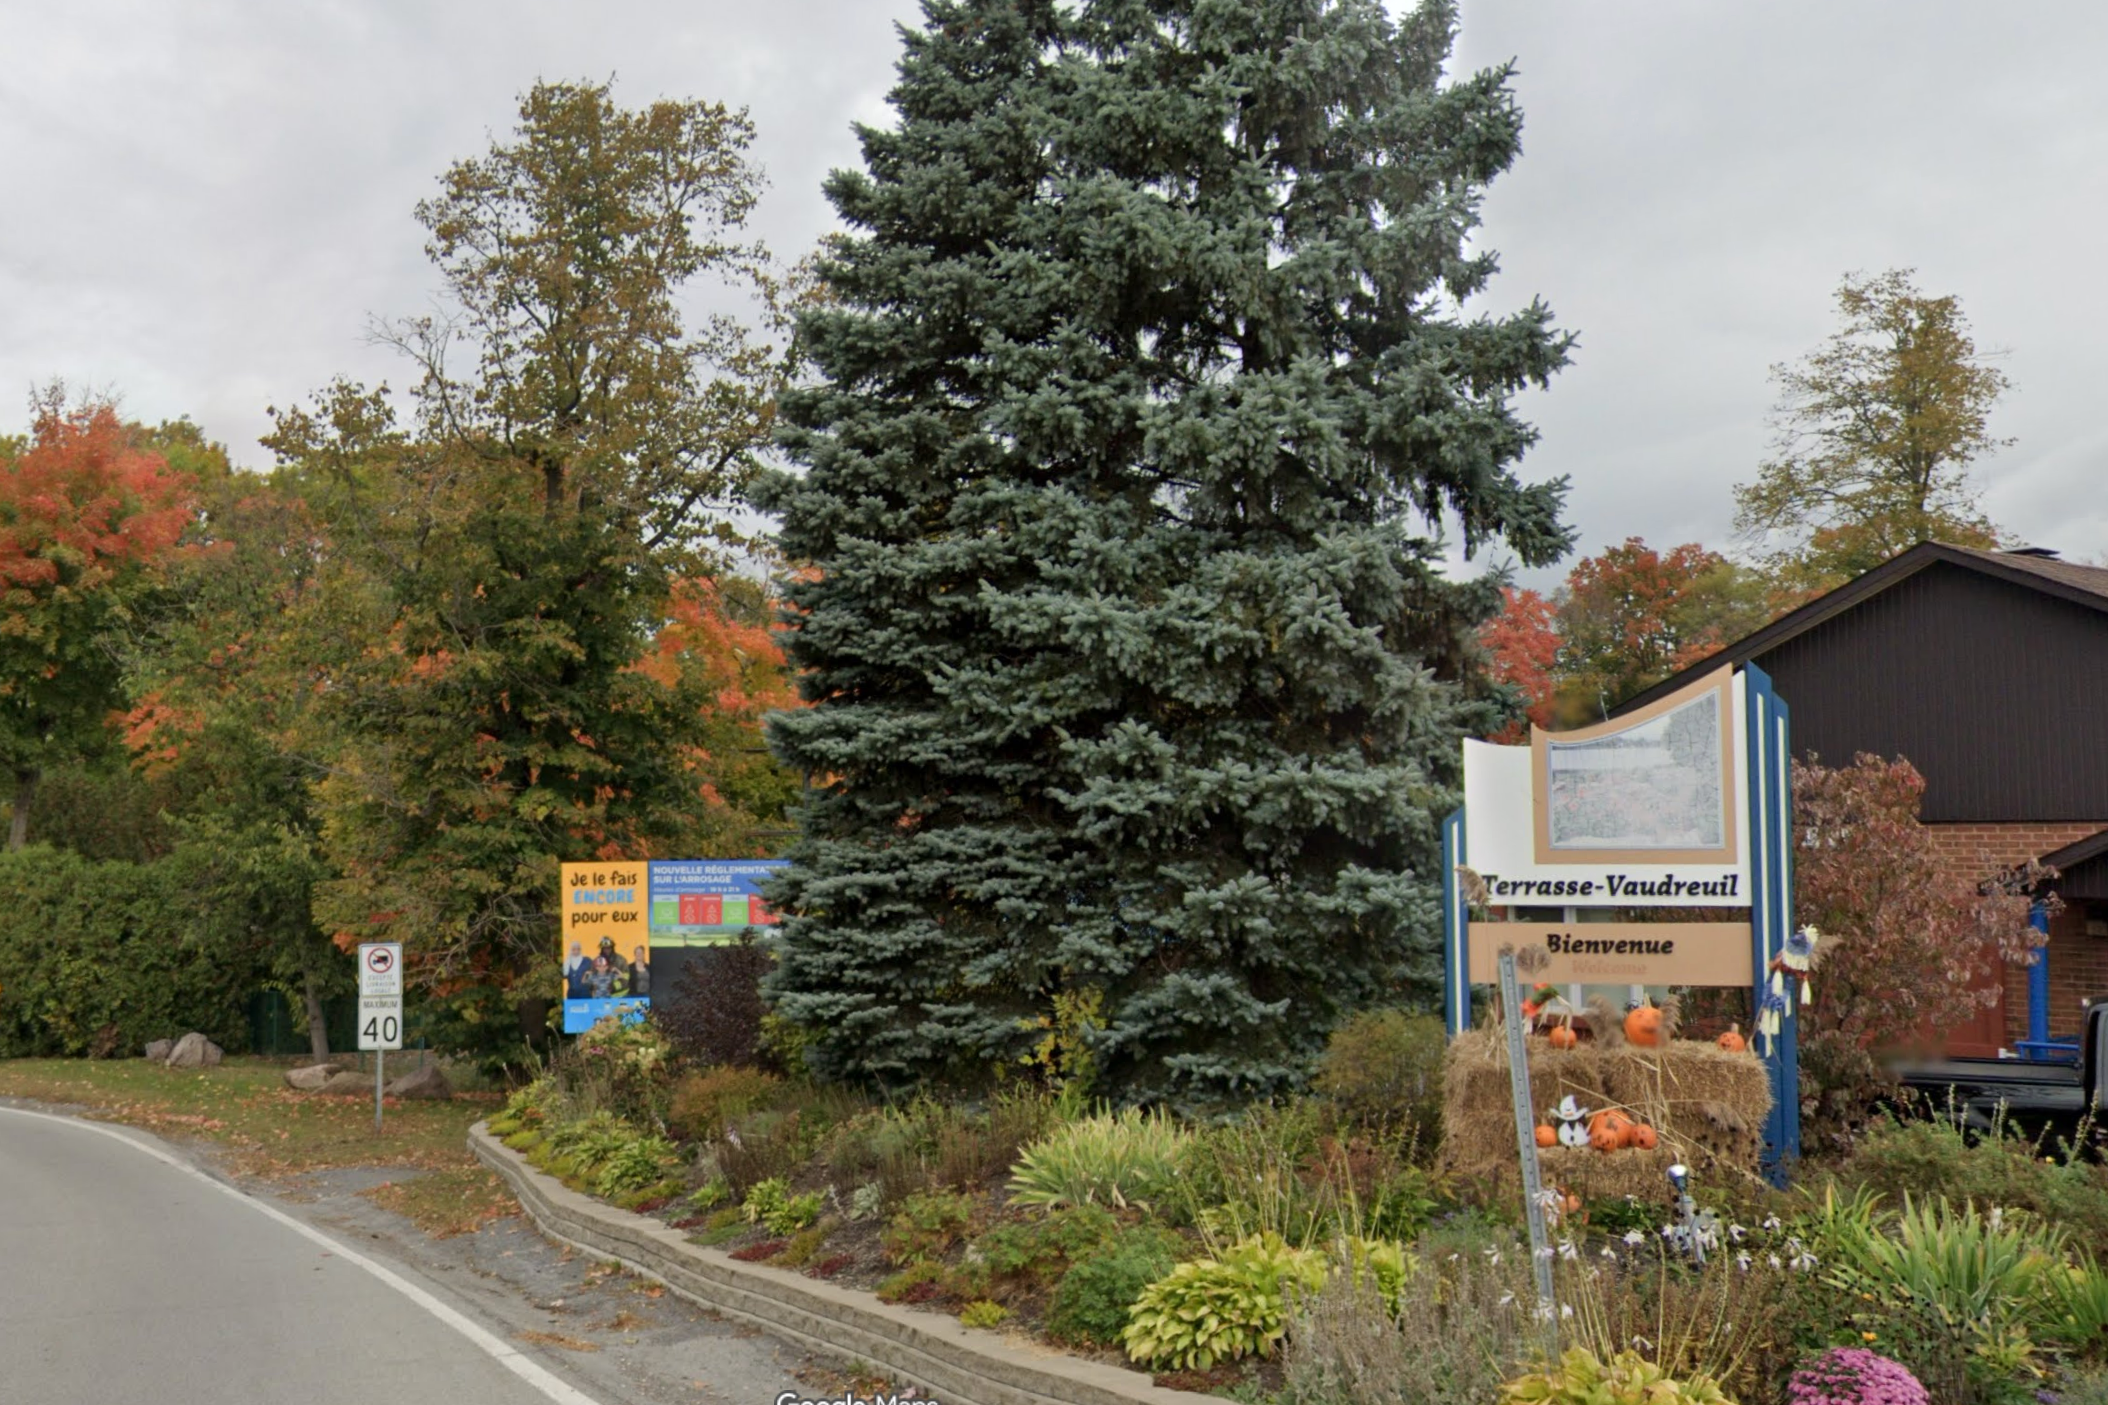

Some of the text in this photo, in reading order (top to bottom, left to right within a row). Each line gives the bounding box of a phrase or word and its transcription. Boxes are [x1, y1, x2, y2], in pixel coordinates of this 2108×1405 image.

[570, 870, 638, 887] Je le fais
[653, 865, 703, 875] NOUVELLE
[653, 875, 732, 884] SUR L'ARROSAGE
[1480, 873, 1739, 897] Terrasse-Vaudreuil
[573, 888, 636, 905] ENCORE
[571, 910, 639, 929] pour eux
[1546, 933, 1675, 955] Bienvenue
[1572, 959, 1648, 975] Welcome
[363, 1016, 398, 1043] 40
